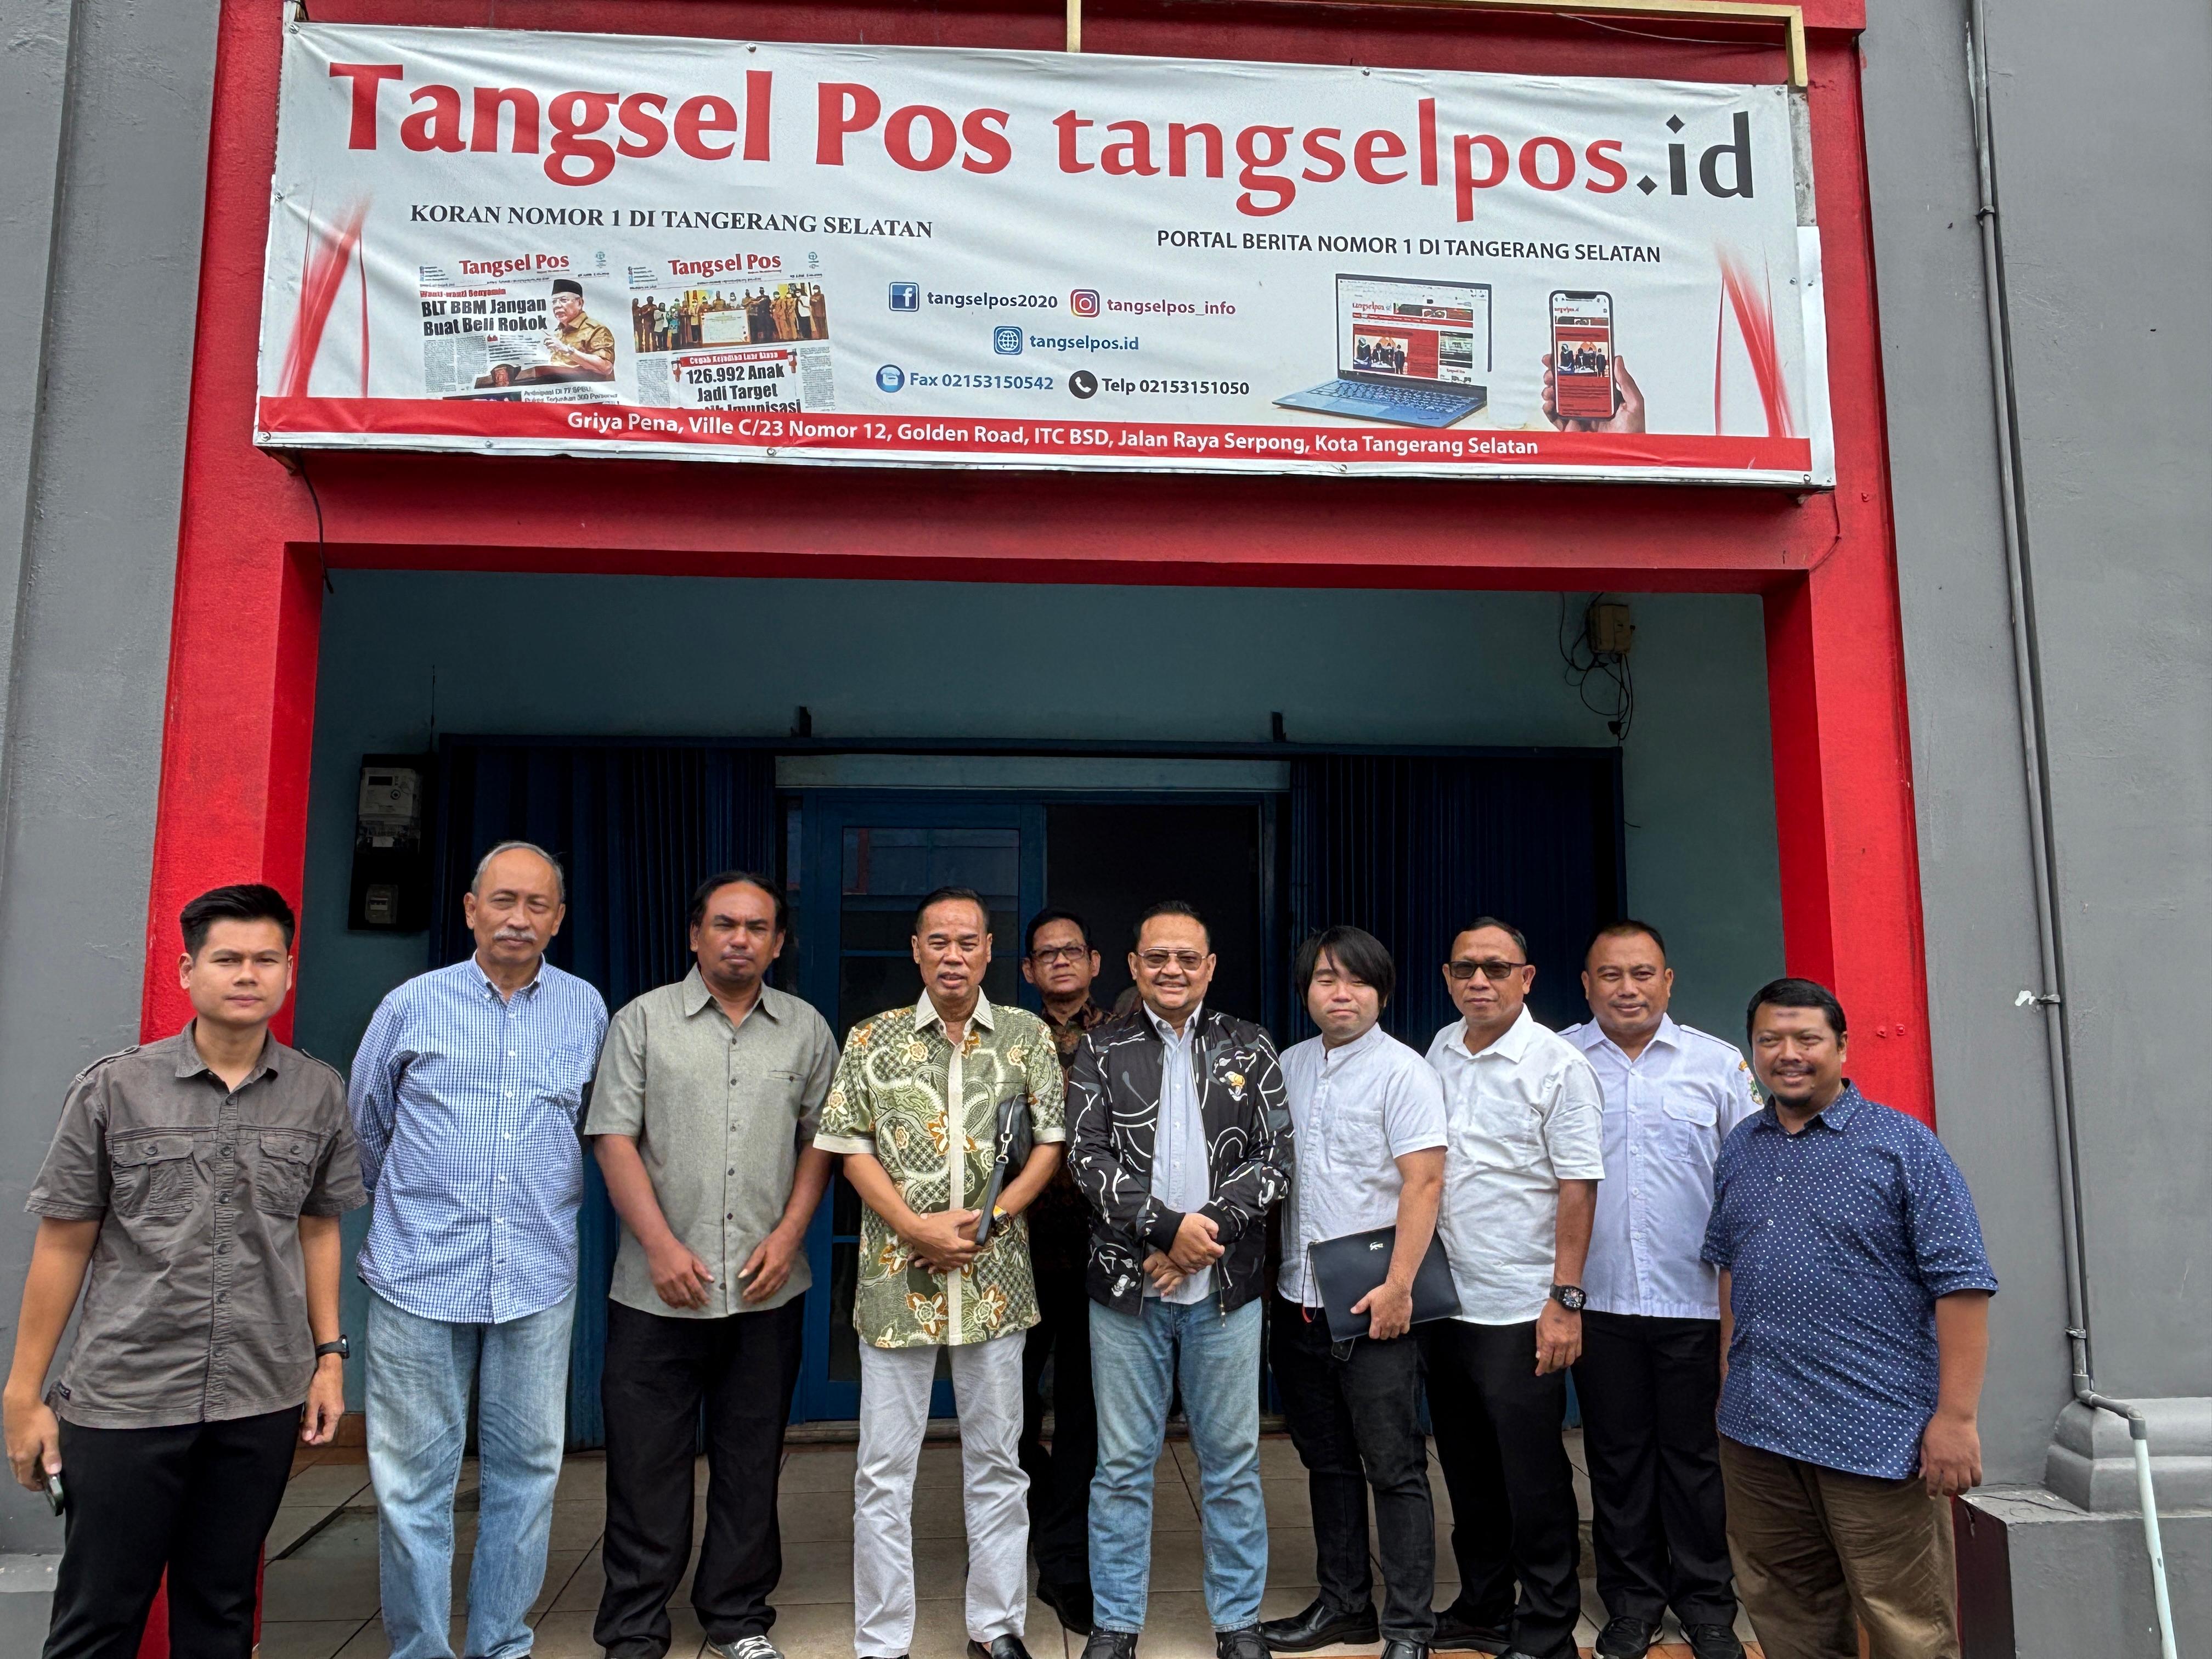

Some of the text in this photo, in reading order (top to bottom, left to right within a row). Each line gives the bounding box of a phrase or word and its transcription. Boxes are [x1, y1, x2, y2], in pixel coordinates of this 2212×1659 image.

[329, 62, 1011, 187] Tangsel Pos
[1053, 98, 1754, 223] tangselpos.id
[410, 204, 933, 239] KORAN NOMOR 1 DI TANGERANG SELATAN
[1158, 229, 1661, 263] PORTAL BERITA NOMOR 1 DI TANGERANG SELATAN
[459, 253, 531, 278] Tangsel
[536, 254, 569, 269] Pos
[668, 253, 742, 278] Tangsel
[747, 253, 782, 269] Pos
[421, 298, 547, 317] BLT BBM Jangan
[927, 291, 1058, 309] tangselpos2020
[1107, 300, 1236, 316] tangselpos_info
[424, 319, 460, 336] Buat
[498, 315, 548, 331] Rokok
[1029, 335, 1139, 353] tangselpos.id
[690, 357, 712, 365] Cegah
[743, 352, 758, 361] Luar
[686, 363, 785, 384] 126.992 Anak
[910, 372, 1054, 391] Fax 02153150542
[697, 383, 778, 402] Jadi Target
[1102, 377, 1250, 396] Telp 02153151050
[568, 411, 1538, 458] Griya Pena, Ville C/23 Nomor 12, Golden Road, ITC BSD, Jalan Raya Serpong, Kota Tangerang Selatan
